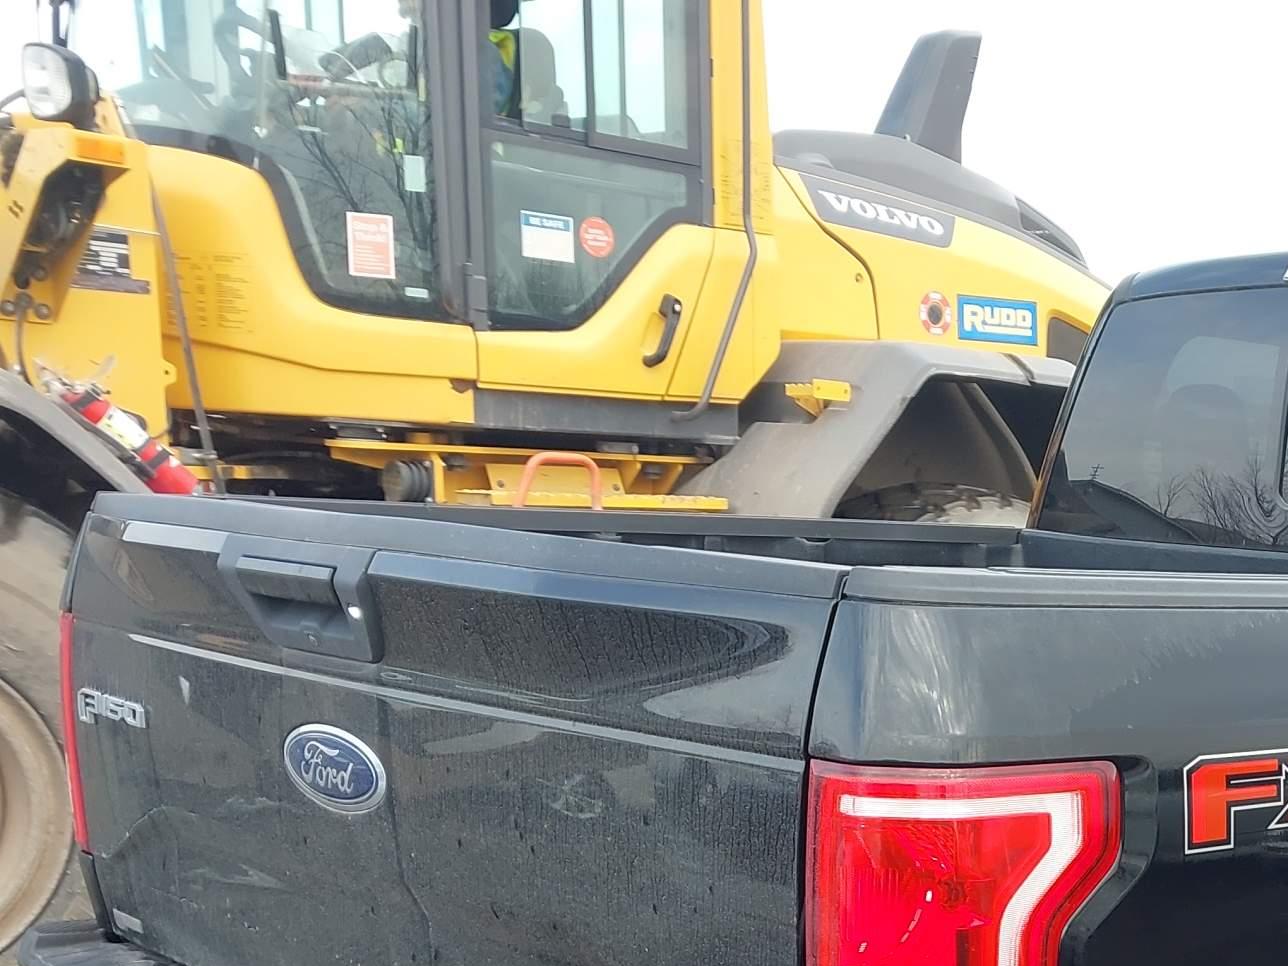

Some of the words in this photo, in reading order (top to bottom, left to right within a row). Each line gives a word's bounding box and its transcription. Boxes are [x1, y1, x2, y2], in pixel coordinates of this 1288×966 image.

[817, 189, 945, 235] VOLVO
[963, 303, 1033, 334] RUDD
[301, 739, 355, 795] Ford
